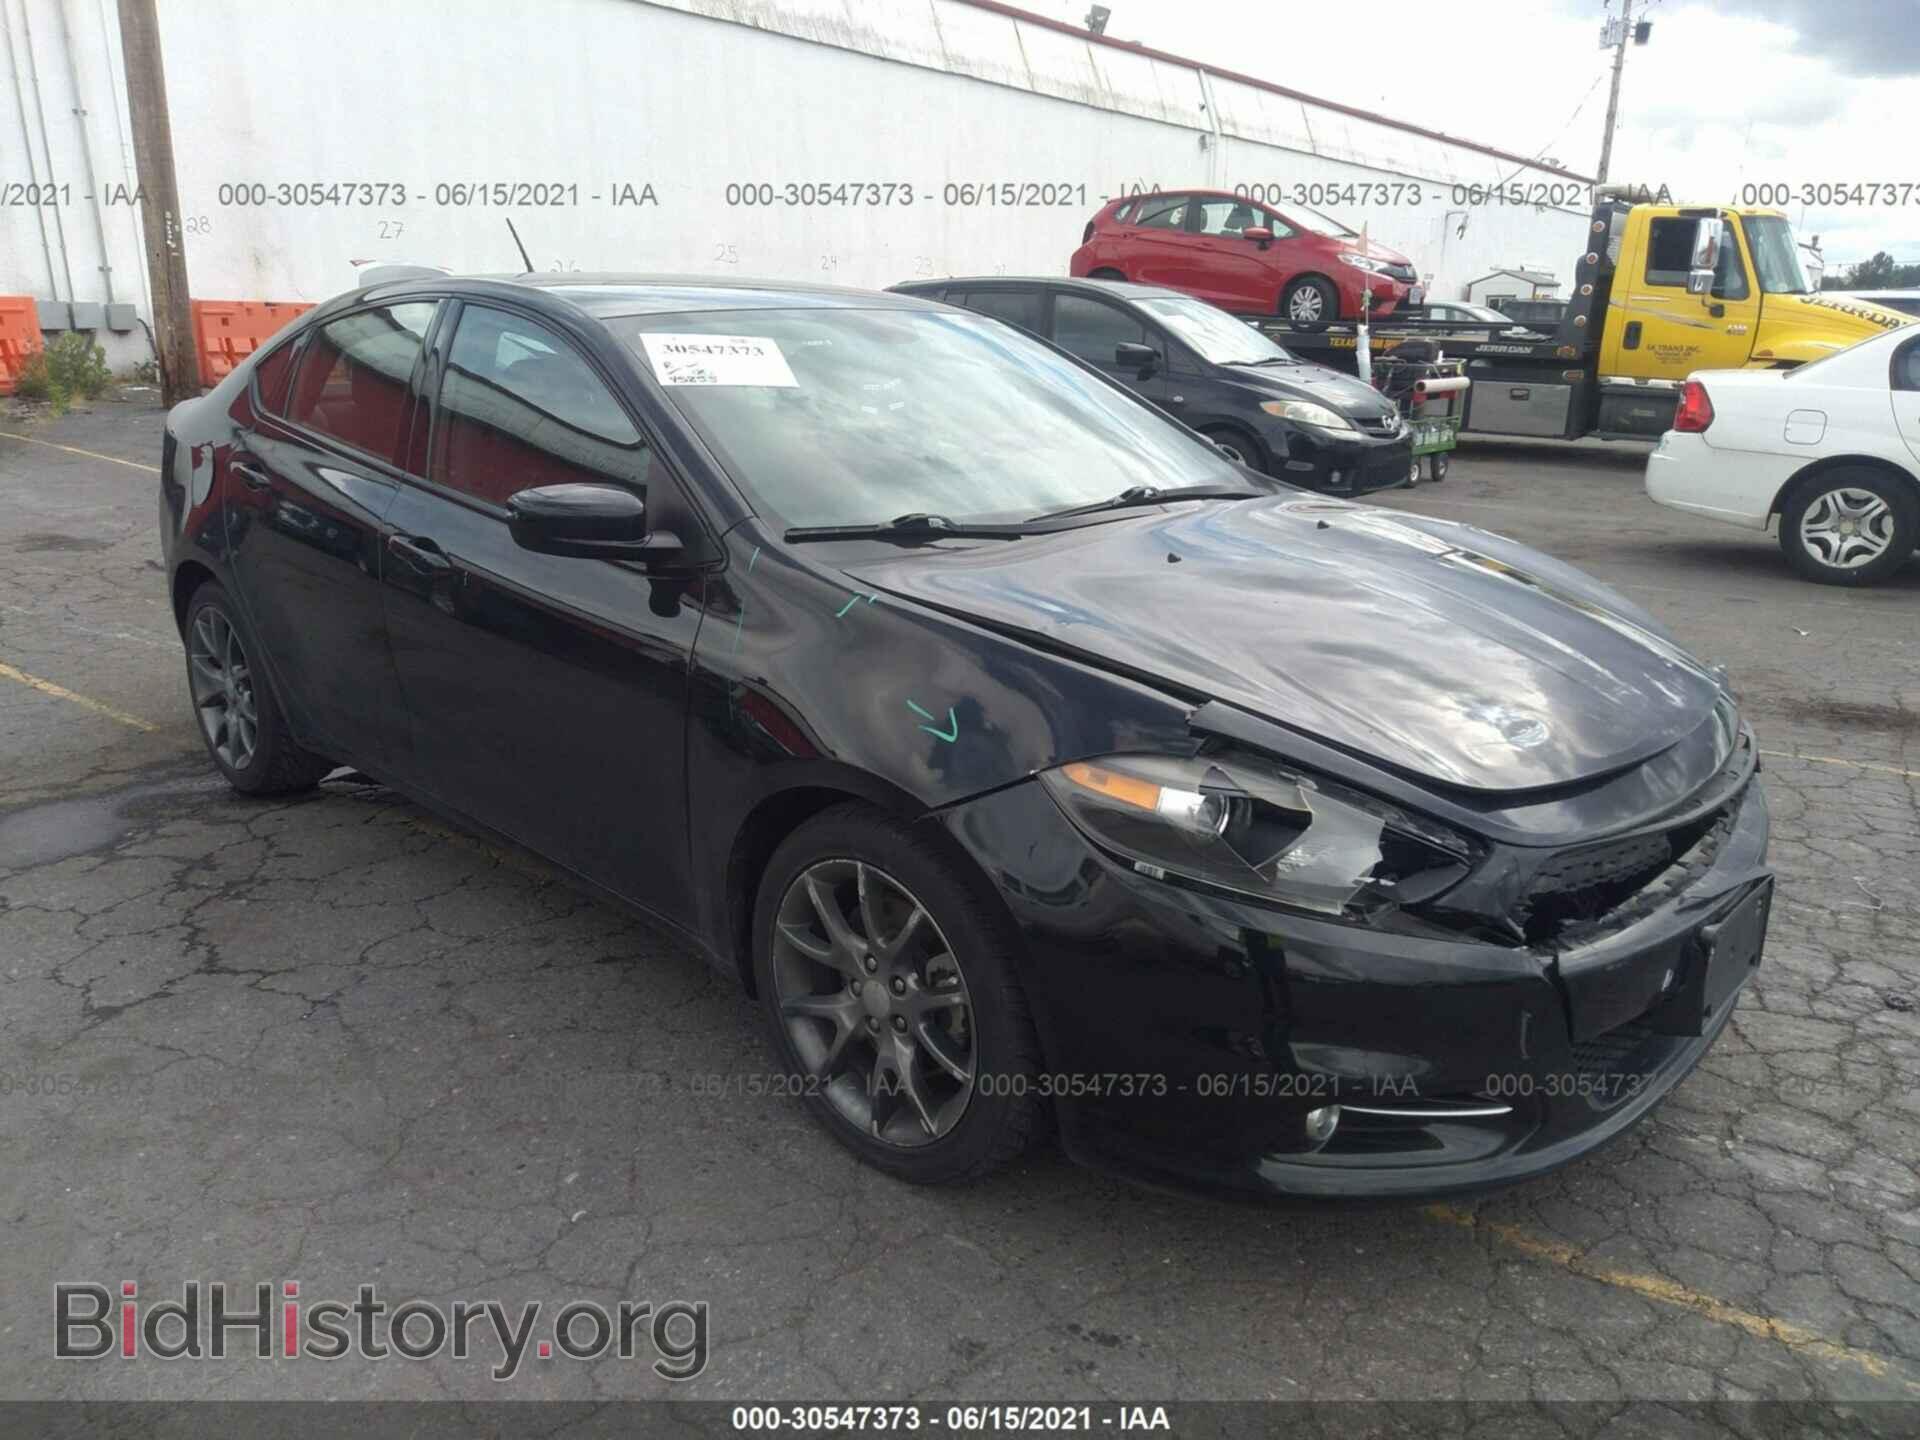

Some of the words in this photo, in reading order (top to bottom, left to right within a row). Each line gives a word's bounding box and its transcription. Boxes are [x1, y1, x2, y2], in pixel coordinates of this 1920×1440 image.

[186, 215, 213, 236] 28
[378, 221, 405, 240] 27
[714, 243, 739, 264] 25
[821, 255, 838, 271] 24
[663, 344, 765, 357] 30547373
